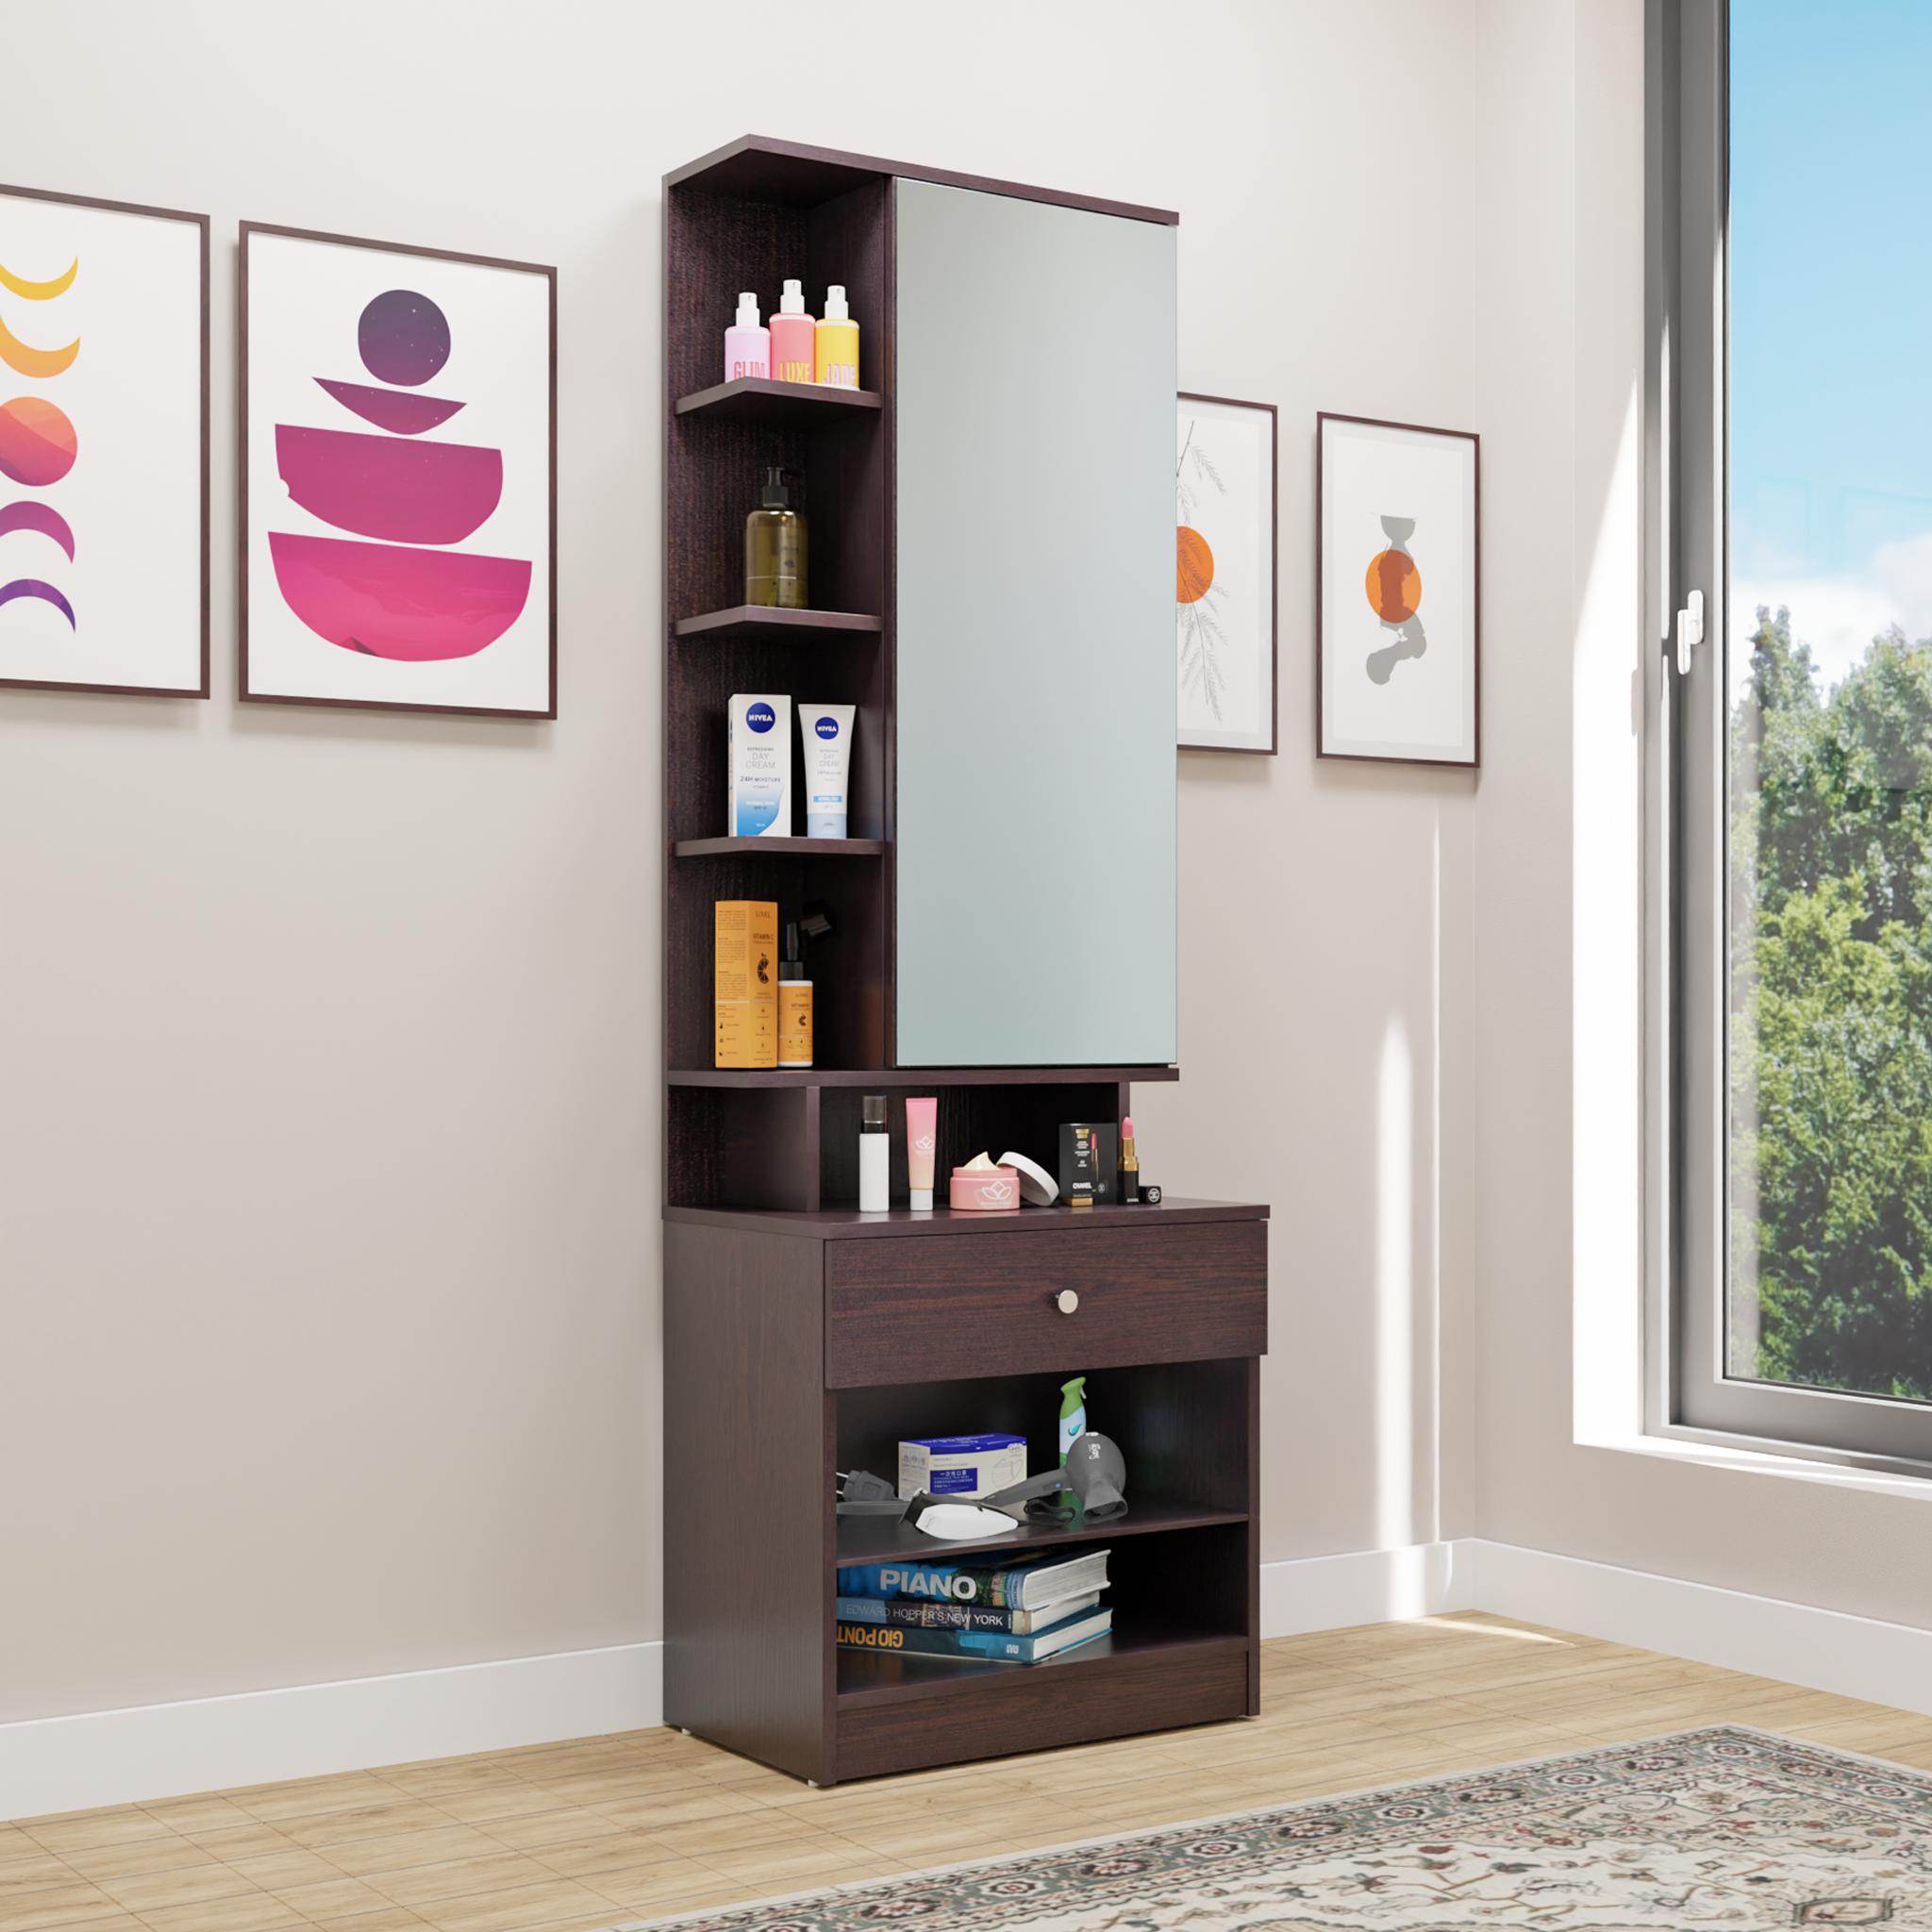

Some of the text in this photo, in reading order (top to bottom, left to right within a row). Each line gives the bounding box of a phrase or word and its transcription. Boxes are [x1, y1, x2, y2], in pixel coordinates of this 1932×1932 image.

[779, 361, 811, 383] LUXE
[823, 363, 857, 387] JADE
[745, 760, 775, 769] CREAM
[880, 1569, 977, 1600] PIANO
[846, 1605, 891, 1617] EDWARD
[893, 1608, 945, 1622] HOPPER'S
[946, 1612, 971, 1624] NEW
[974, 1613, 1003, 1626] YORK
[878, 1629, 904, 1648] GIO
